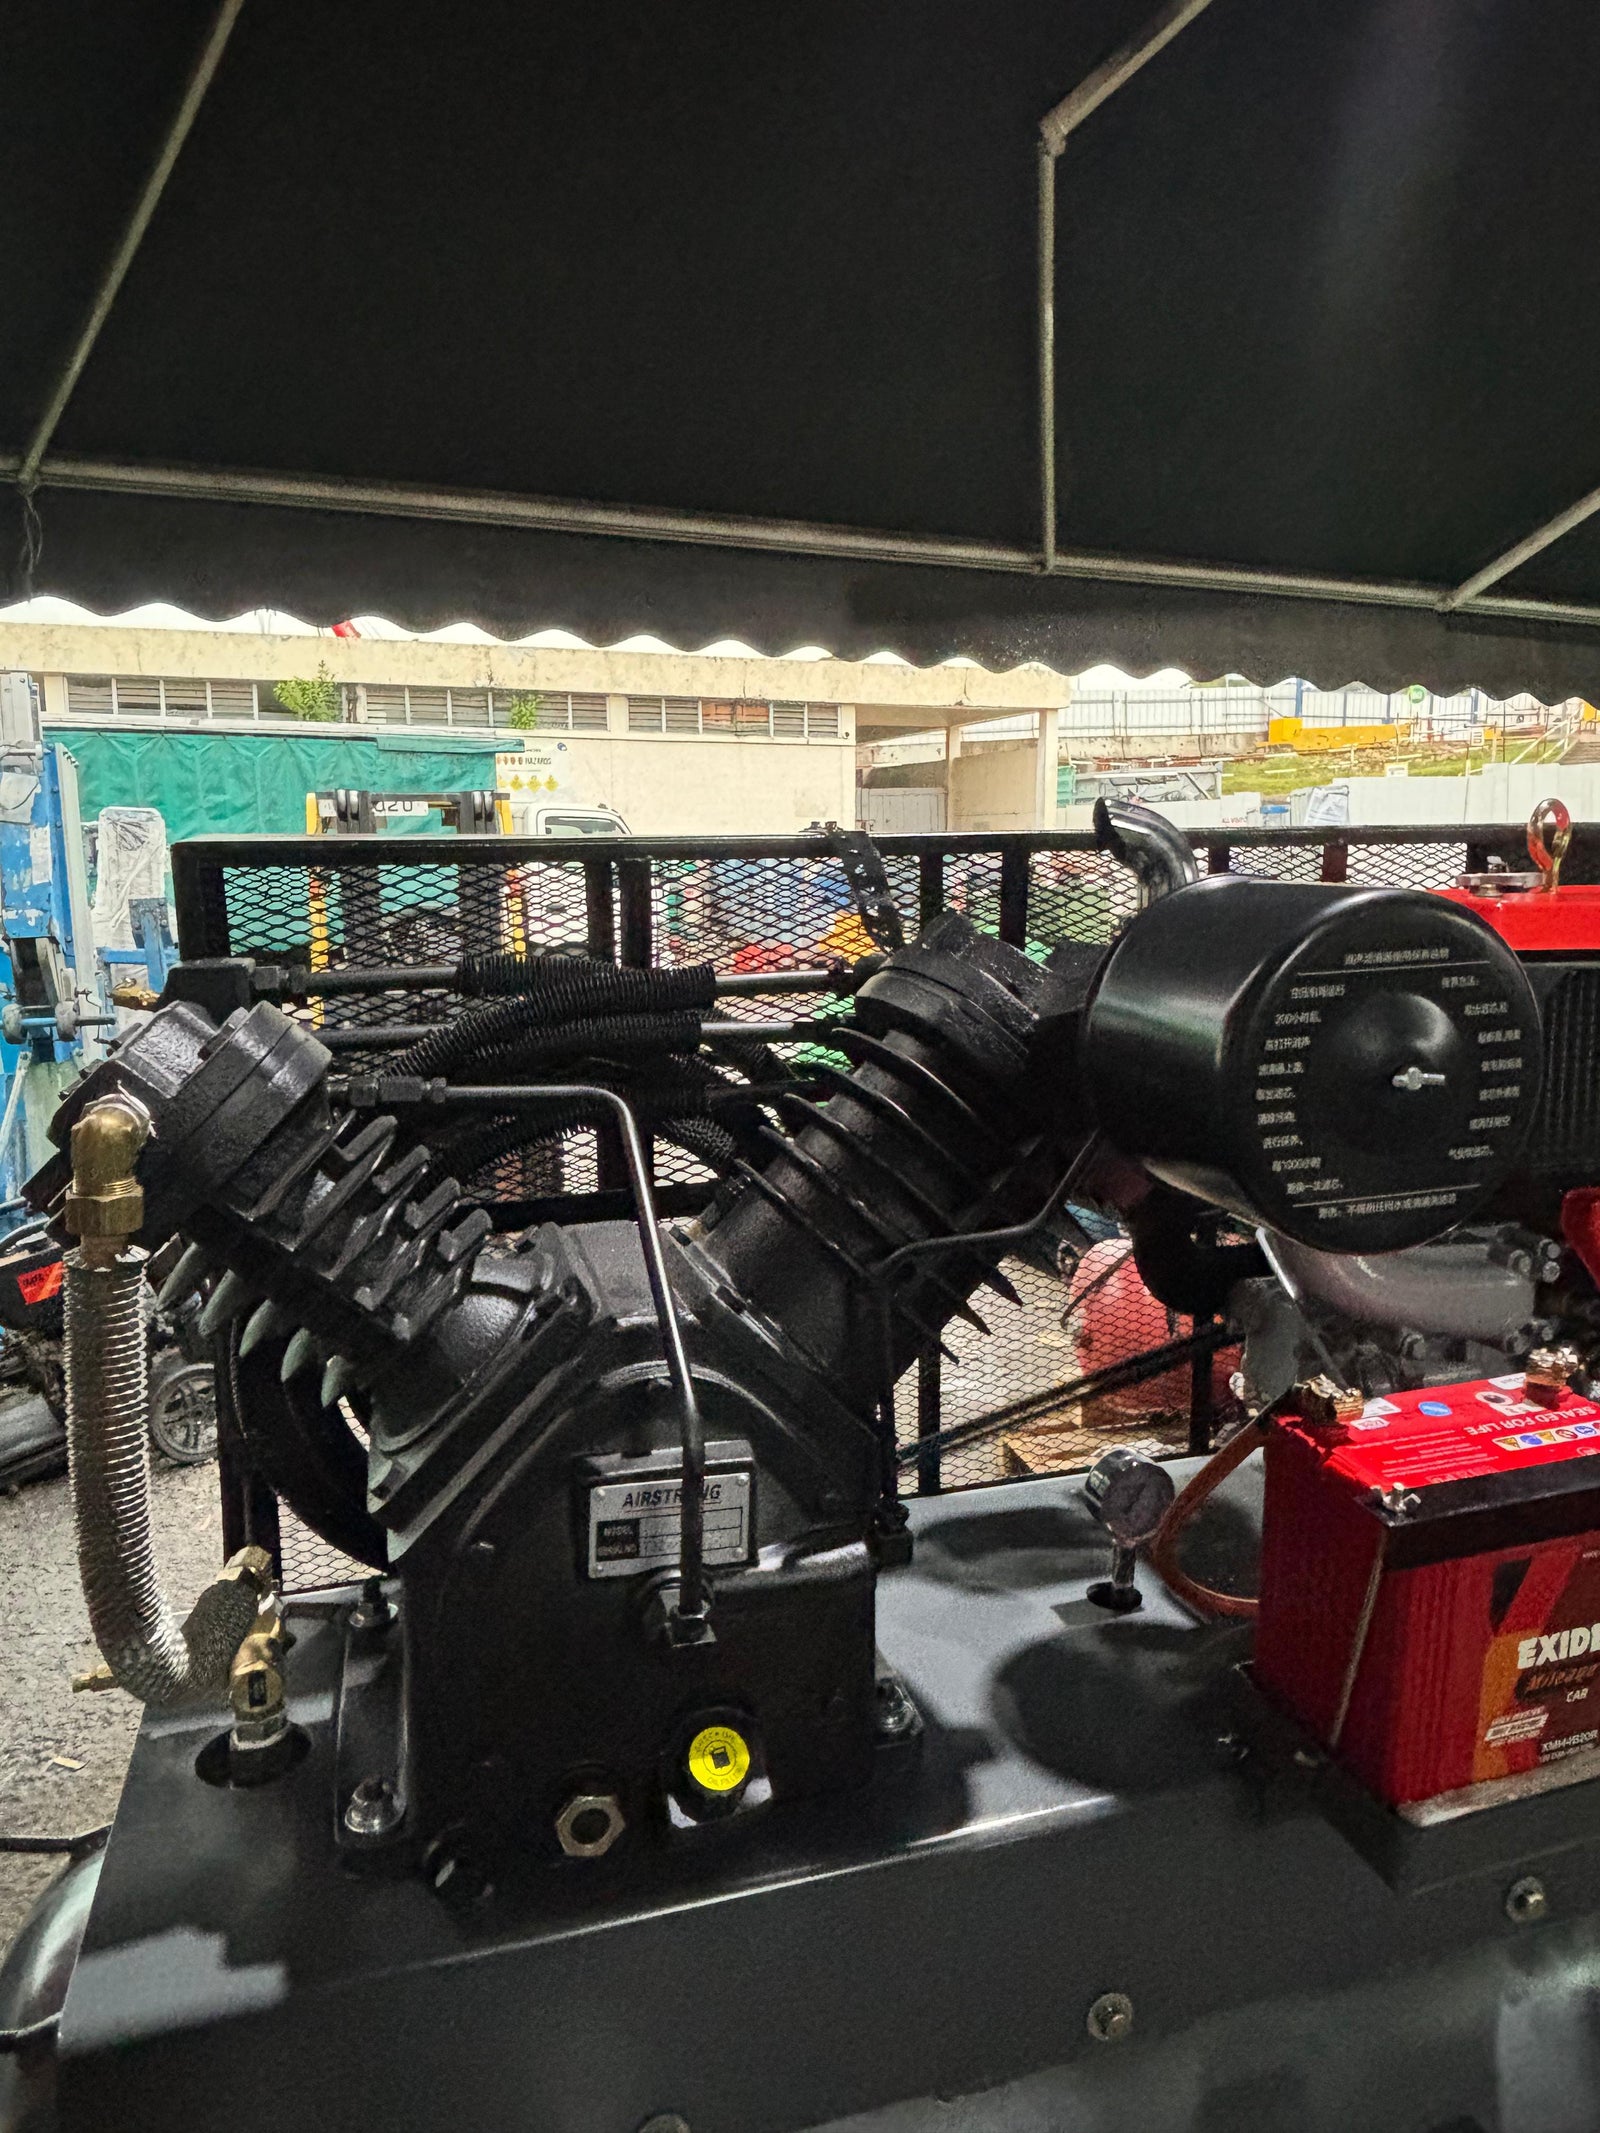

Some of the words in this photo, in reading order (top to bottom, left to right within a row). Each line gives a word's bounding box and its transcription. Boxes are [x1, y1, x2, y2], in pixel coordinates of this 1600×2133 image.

[1499, 1416, 1535, 1430] FOR
[1534, 1406, 1597, 1424] SEALED
[1463, 1422, 1502, 1436] LIFE
[622, 1483, 722, 1508] AIRSTRNG
[1566, 1687, 1589, 1703] CAR
